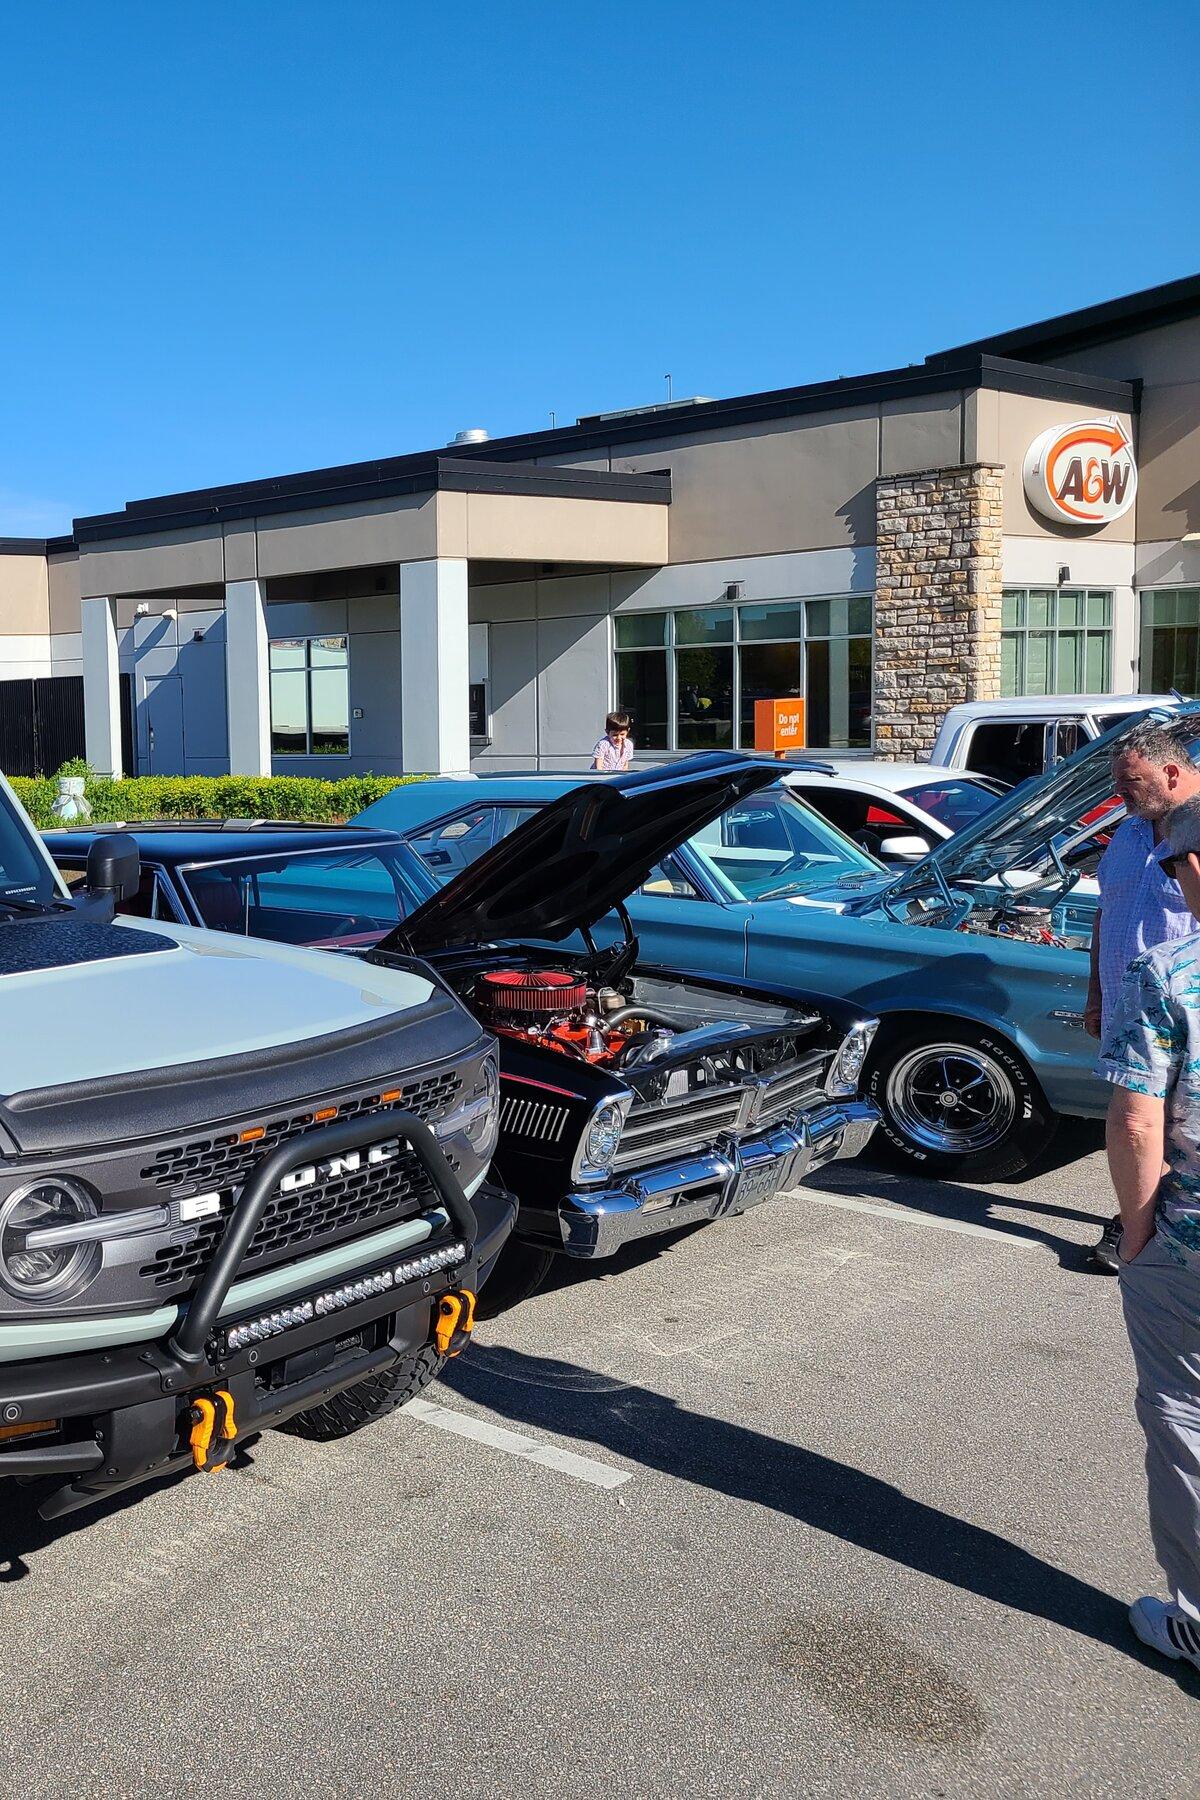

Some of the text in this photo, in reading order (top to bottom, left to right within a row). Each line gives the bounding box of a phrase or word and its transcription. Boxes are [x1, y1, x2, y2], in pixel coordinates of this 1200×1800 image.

[1055, 456, 1131, 505] A&W
[779, 712, 800, 725] Do not
[780, 725, 798, 737] enter
[1022, 1093, 1033, 1120] T/A
